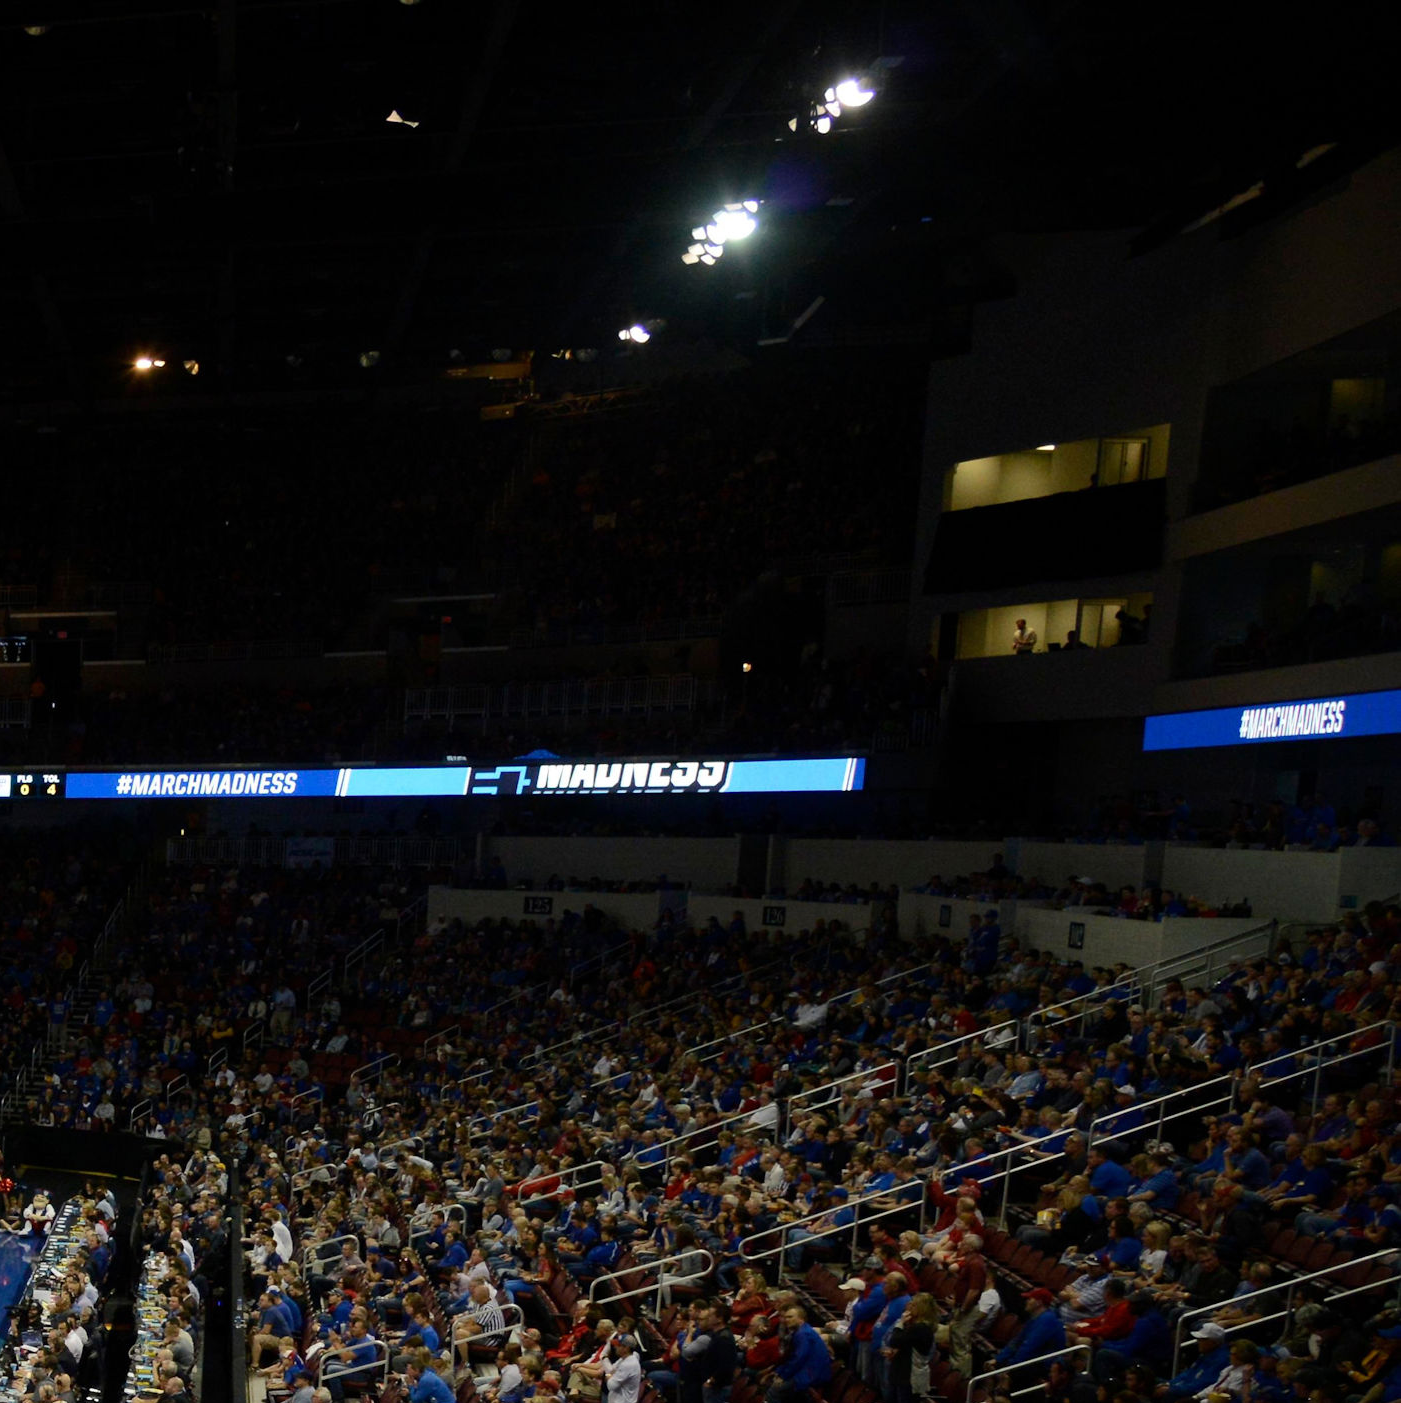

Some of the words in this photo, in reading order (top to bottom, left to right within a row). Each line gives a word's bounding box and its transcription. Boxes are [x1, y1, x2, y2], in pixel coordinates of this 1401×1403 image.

[1239, 701, 1346, 739] #MARCHMADNESS
[20, 784, 30, 795] 0
[46, 784, 56, 795] 4
[116, 772, 297, 796] #MARCHMADNESS
